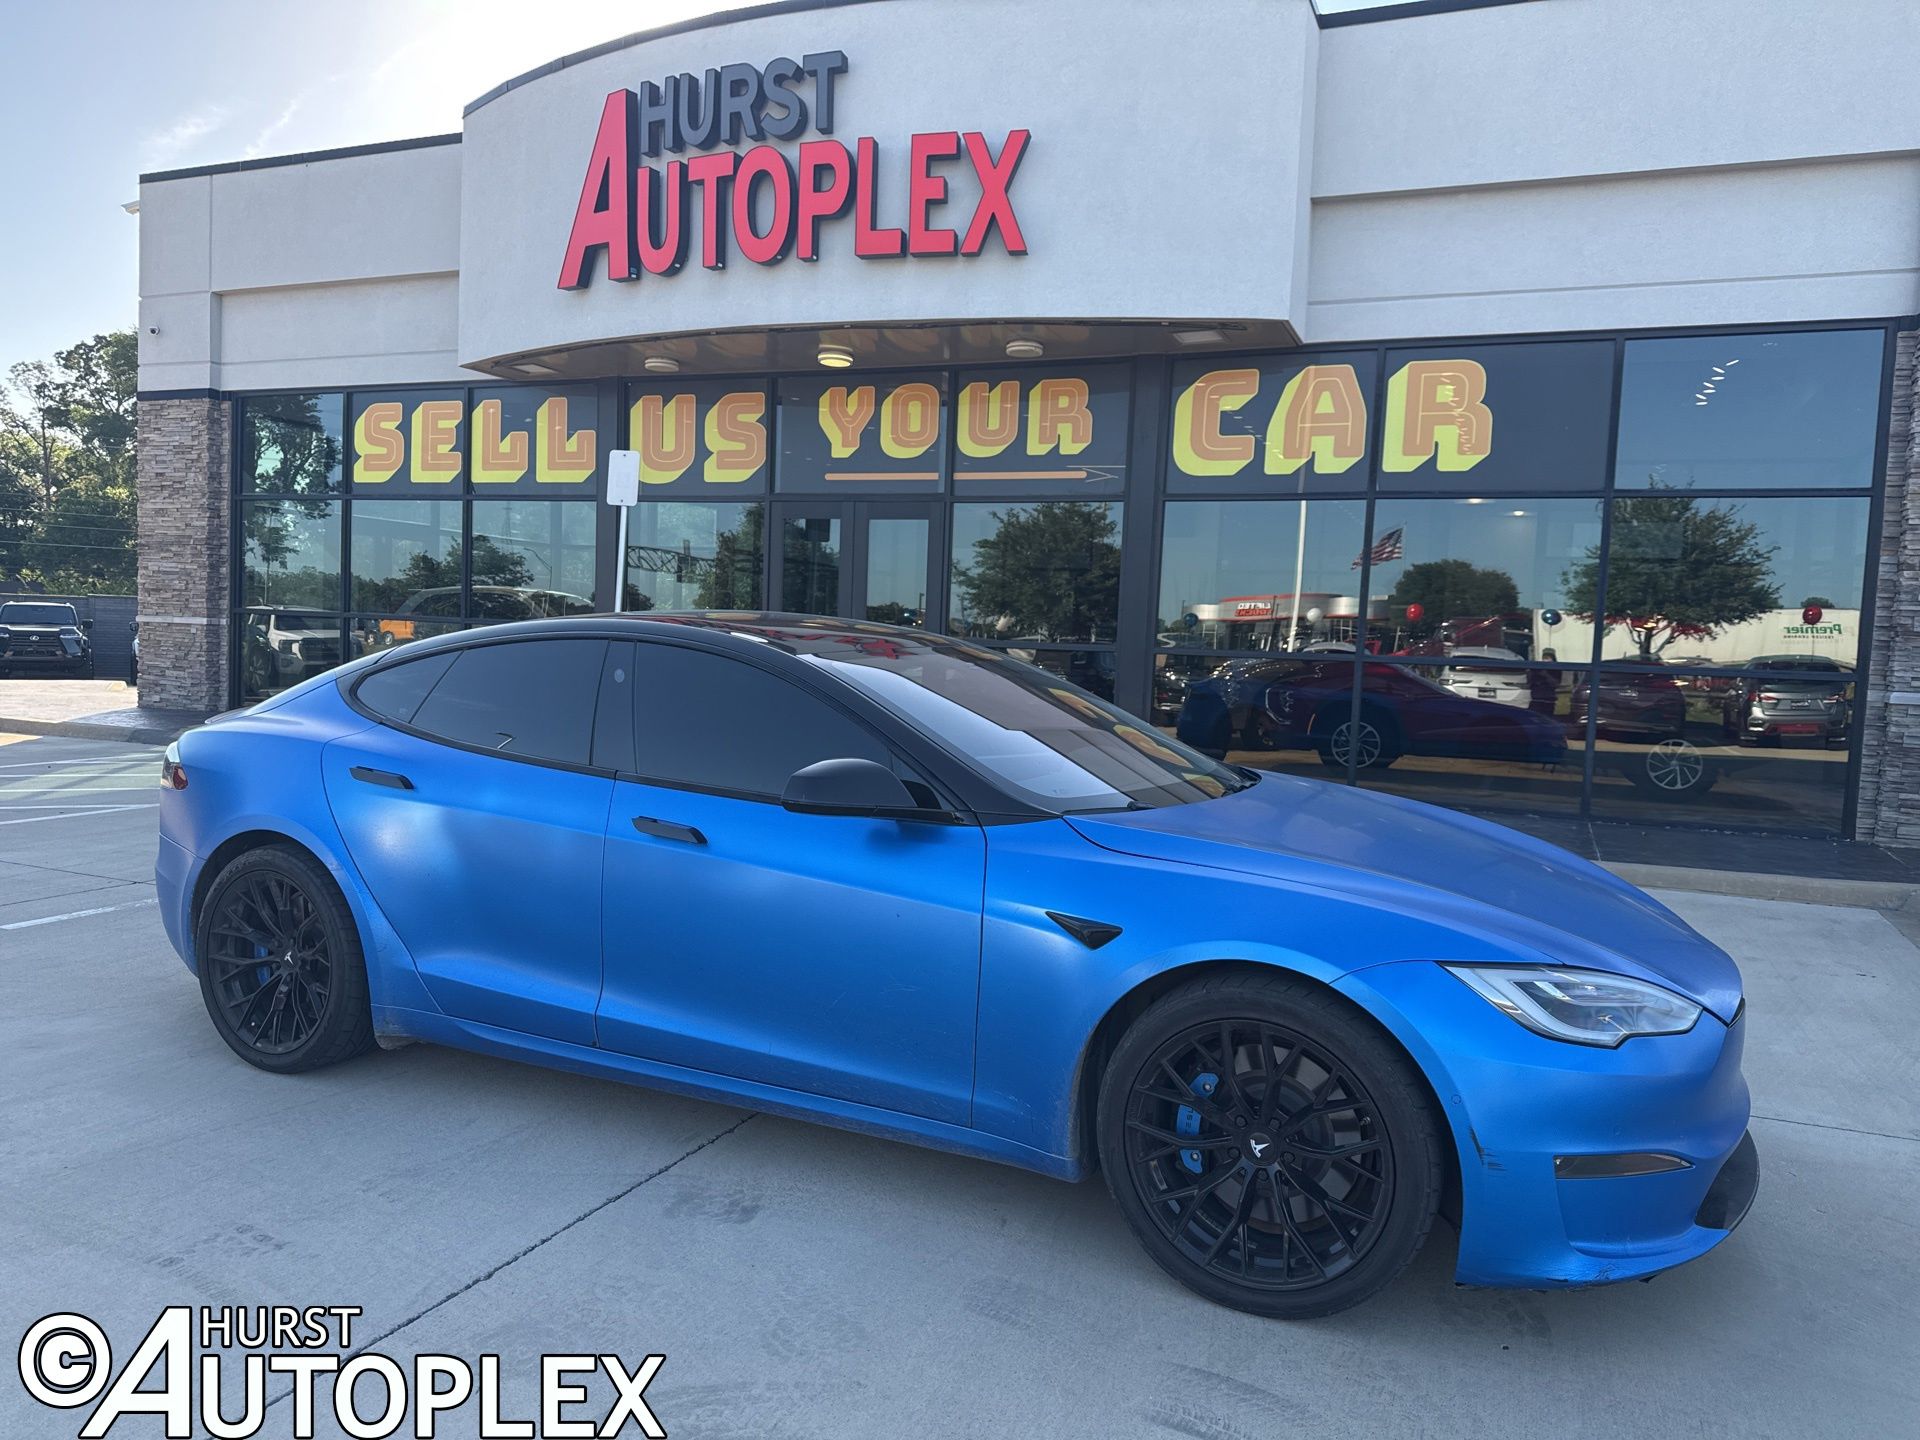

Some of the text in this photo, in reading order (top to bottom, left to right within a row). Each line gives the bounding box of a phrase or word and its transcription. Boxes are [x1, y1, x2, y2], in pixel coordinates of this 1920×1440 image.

[640, 50, 848, 158] HURST
[557, 88, 1031, 291] AUTOPLEX
[353, 359, 1494, 484] SELL US YOUR CAR
